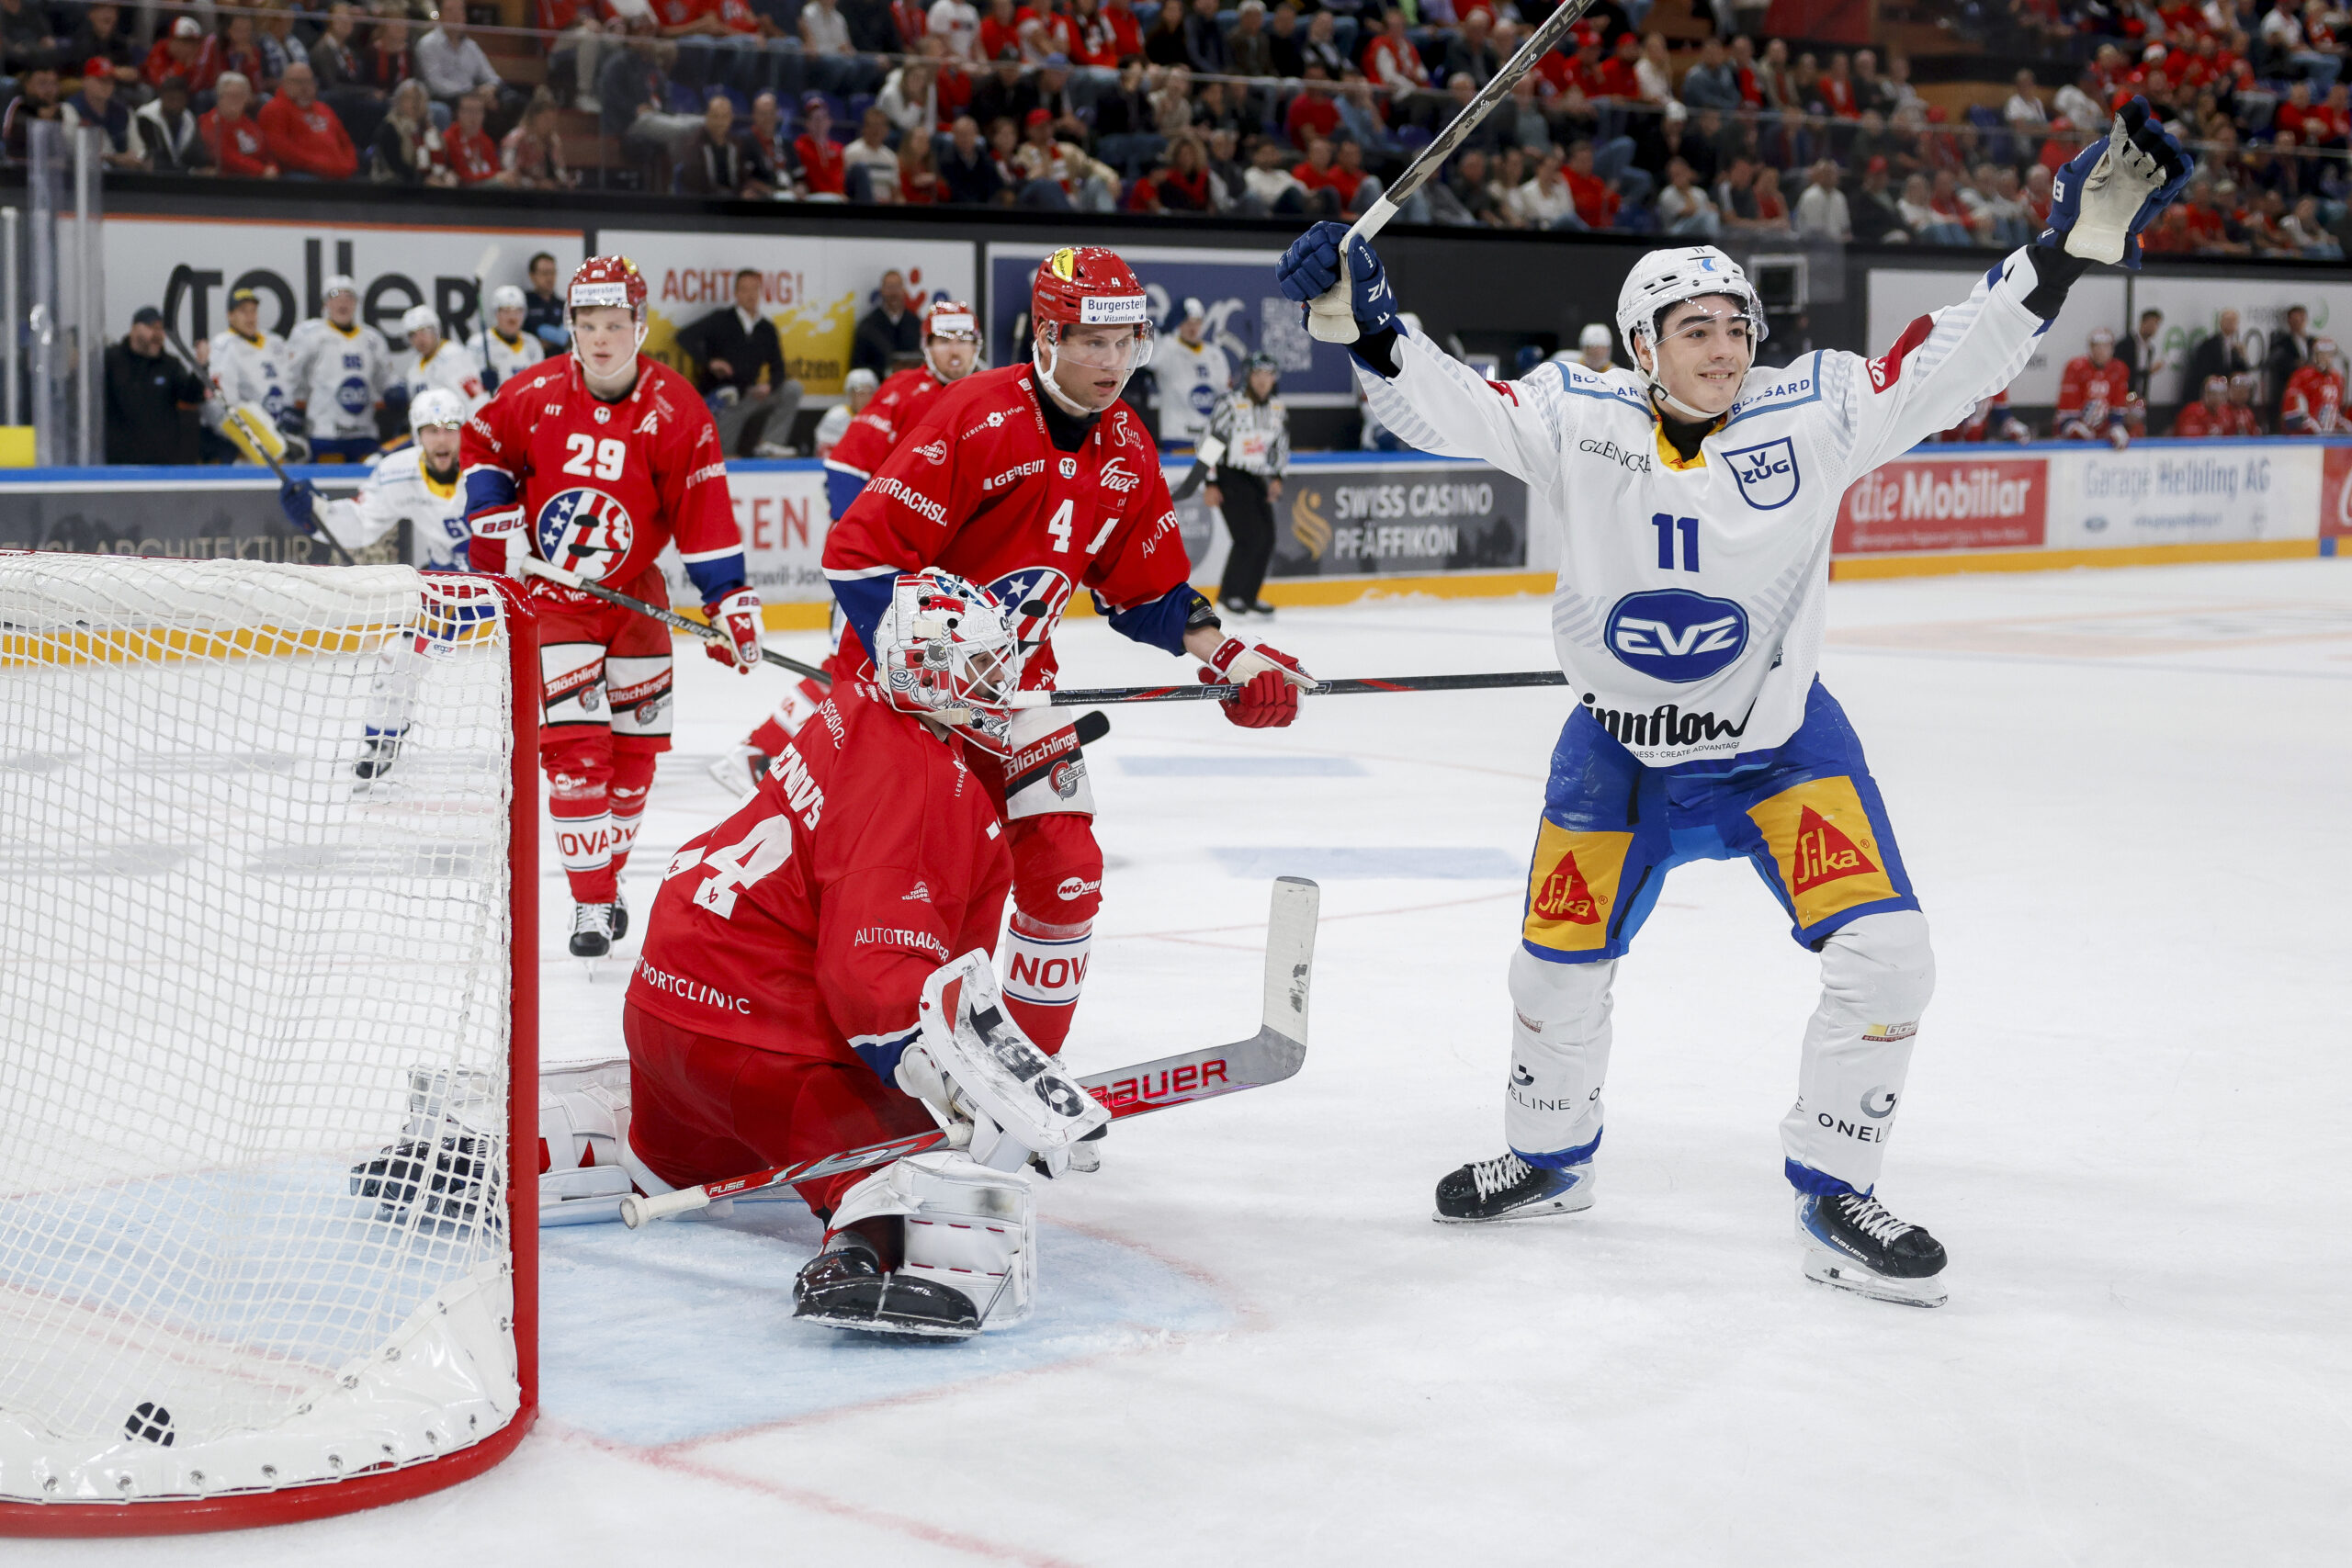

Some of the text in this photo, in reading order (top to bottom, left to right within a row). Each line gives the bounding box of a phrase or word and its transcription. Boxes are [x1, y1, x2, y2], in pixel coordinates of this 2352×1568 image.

[1359, 245, 1374, 268] CCM
[662, 268, 804, 304] ACHTNG!
[1111, 276, 1121, 287] 4
[1088, 297, 1146, 313] Burgerstein
[1103, 313, 1136, 322] Vitamine
[562, 433, 626, 481] 29
[1741, 458, 1791, 484] ZUG
[1749, 451, 1766, 468] V
[2245, 457, 2271, 493] AG
[863, 477, 947, 526] UTOTRACHSL
[1335, 482, 1494, 520] SWISS CASINO
[1849, 468, 2031, 524] die Mobiliar
[481, 518, 527, 535] BAU
[1047, 499, 1074, 554] 4
[1335, 521, 1459, 559] PFÄFFIKON
[1651, 513, 1700, 573] 11
[1615, 615, 1739, 658] EVZ
[1003, 731, 1078, 781] Blöchlinge
[1660, 750, 1690, 758] CREATE
[1058, 764, 1087, 785] KREISLAU
[1797, 828, 1860, 885] Sika
[1538, 874, 1591, 917] Sika
[1010, 949, 1091, 988] NOV
[708, 1179, 746, 1196] FUSE
[1830, 1235, 1870, 1262] BAUER
